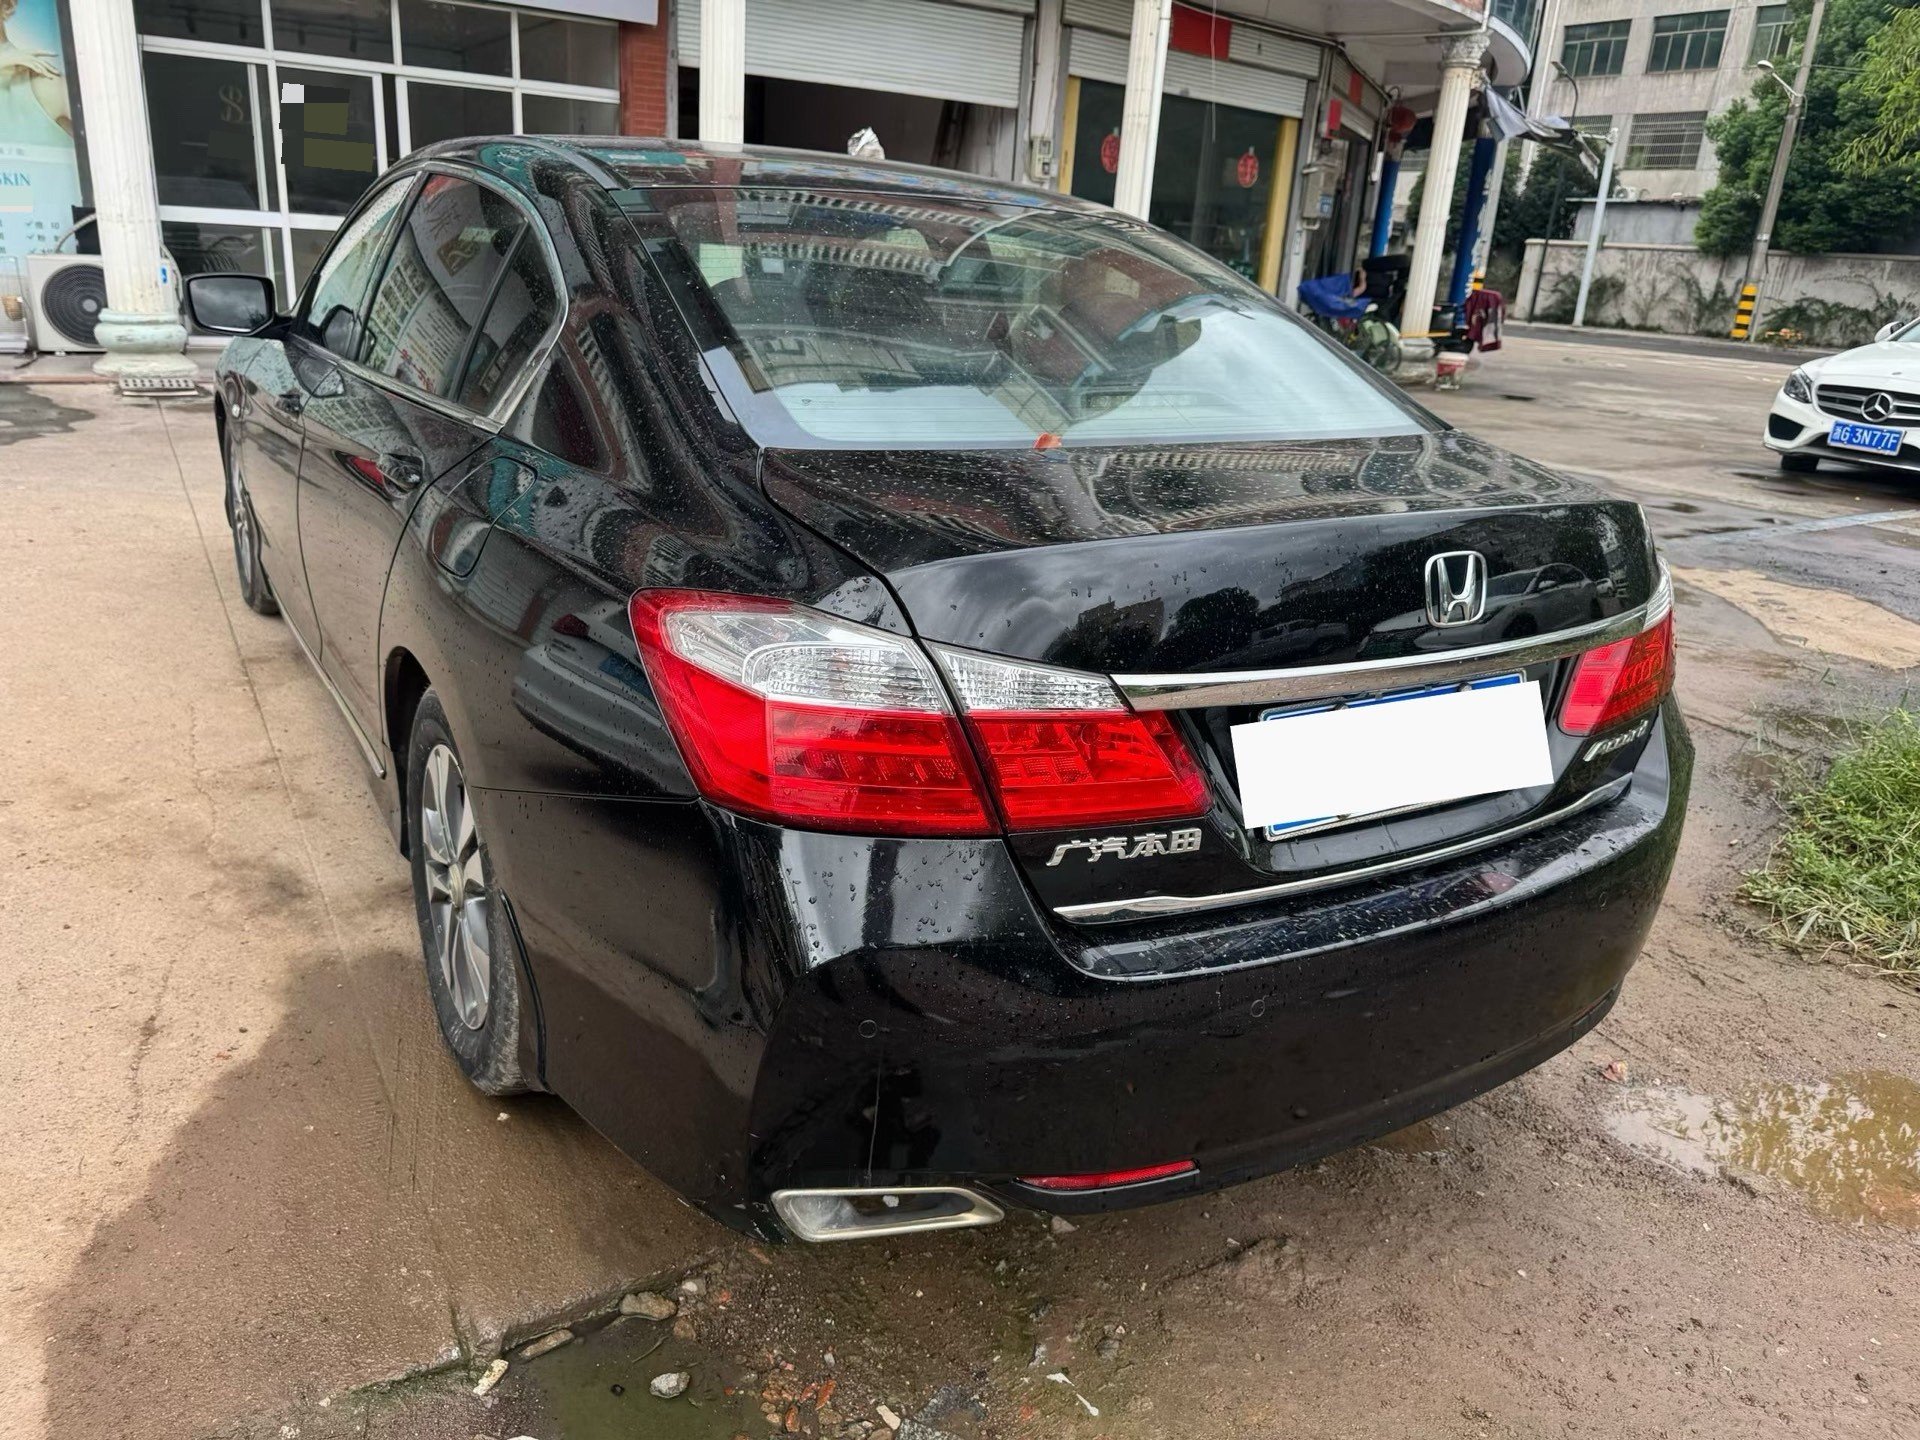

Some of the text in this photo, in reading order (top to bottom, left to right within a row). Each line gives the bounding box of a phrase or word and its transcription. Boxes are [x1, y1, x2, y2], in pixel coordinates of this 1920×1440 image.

[0, 172, 31, 186] KIN
[1045, 827, 1202, 867] 广汽本田
